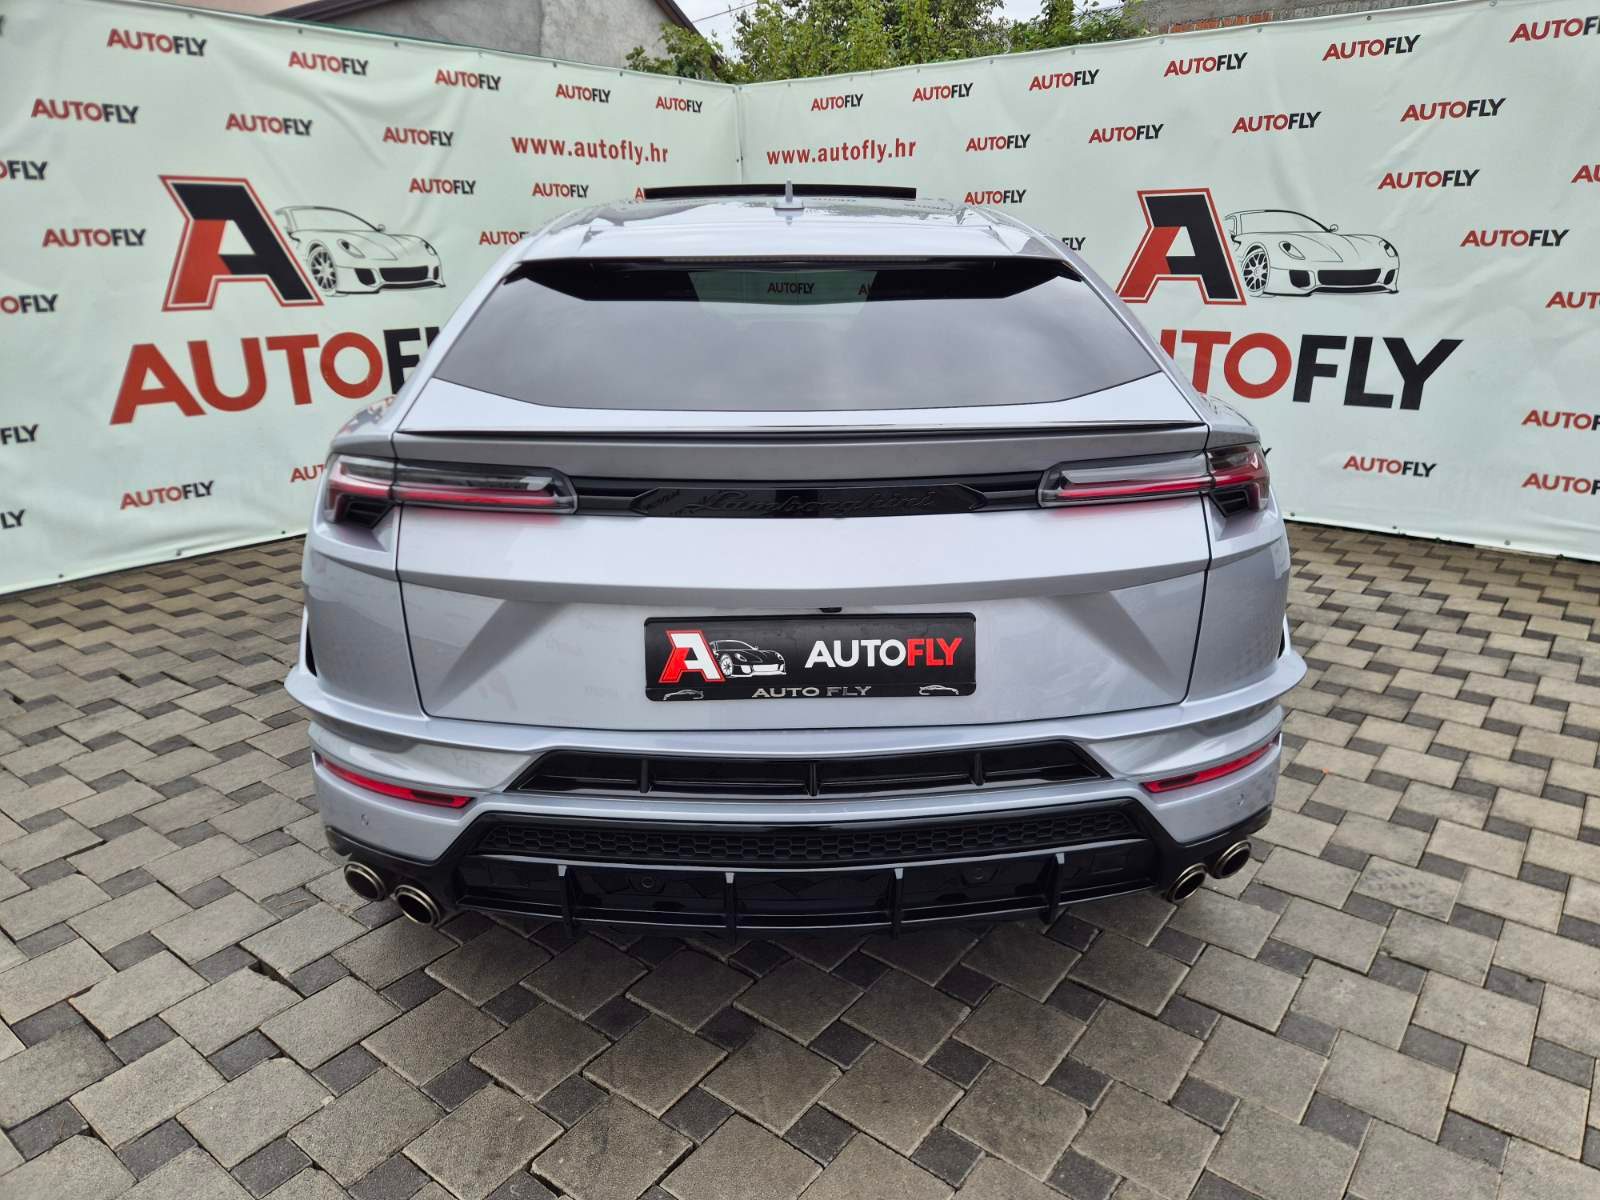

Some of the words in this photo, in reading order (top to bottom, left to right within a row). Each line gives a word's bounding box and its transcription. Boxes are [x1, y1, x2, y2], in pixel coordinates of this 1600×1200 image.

[1509, 16, 1600, 43] AUTOF
[107, 29, 207, 56] AUTOFLY
[1322, 35, 1421, 61] AUTOFLY
[289, 51, 368, 76] AUTOFLY
[1164, 52, 1247, 77] AUTOFLY
[435, 70, 501, 91] AUTOFLY
[1029, 69, 1099, 91] AUTOFLY
[556, 84, 611, 103] AUTOFLY
[811, 94, 863, 111] AUTOFLY
[912, 83, 973, 102] AUTOFLY
[31, 99, 138, 124] AUTOFLY
[656, 96, 702, 113] AUTOFLY
[1400, 98, 1506, 122] AUTOFLY
[226, 113, 312, 136] AUTOFLY
[1232, 112, 1322, 133] AUTOFLY
[383, 127, 454, 146] AUTOFLY
[966, 134, 1031, 152] AUTOFLY
[1089, 124, 1164, 143] AUTOFLY
[512, 137, 668, 165] www.autofly.hr
[767, 138, 916, 165] www.autofly.hr
[409, 178, 476, 194] AUTOFLY
[1378, 169, 1480, 189] AUTOFLY
[532, 183, 589, 198] AUTOFLY
[964, 190, 1026, 205] AUTOFLY
[42, 229, 146, 247] AUTOFLY
[479, 231, 528, 245] AUTO
[1460, 229, 1569, 247] AUTOFLY
[767, 281, 815, 295] AUTOFLY
[109, 326, 440, 425] AUTOF
[1160, 329, 1464, 411] TOFLY
[1343, 456, 1437, 477] AUTOFLY
[121, 480, 214, 509] AUTOFLY
[804, 637, 963, 668] AUTOFLY
[752, 687, 820, 698] AUTO
[826, 685, 872, 697] FLY
